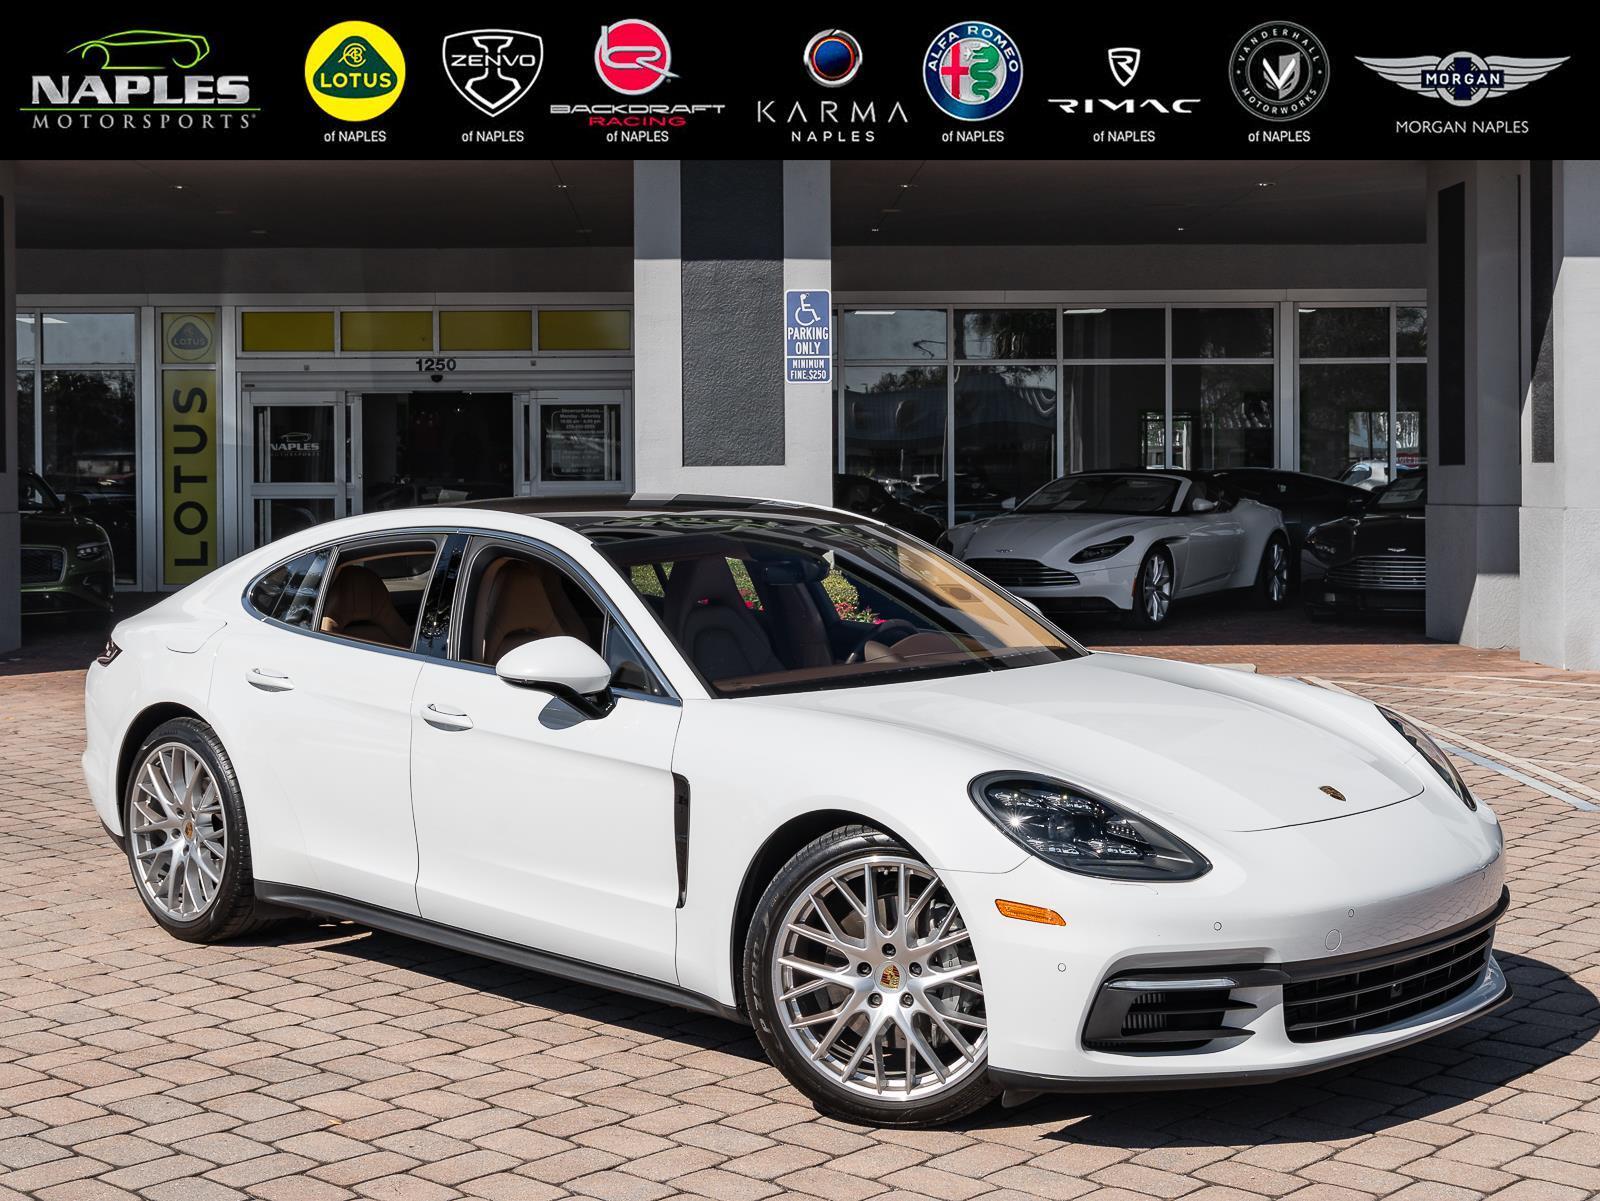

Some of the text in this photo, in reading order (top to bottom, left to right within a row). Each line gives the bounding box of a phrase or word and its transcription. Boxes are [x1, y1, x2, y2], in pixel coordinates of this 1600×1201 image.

[787, 326, 829, 340] PARKING
[174, 337, 206, 346] LOTUS
[795, 341, 821, 355] ONLY
[416, 358, 457, 372] 1250
[792, 359, 825, 369] MINIMUM
[790, 370, 827, 380] FINE $250
[270, 442, 320, 451] NAPLES
[172, 387, 208, 566] LOTUS
